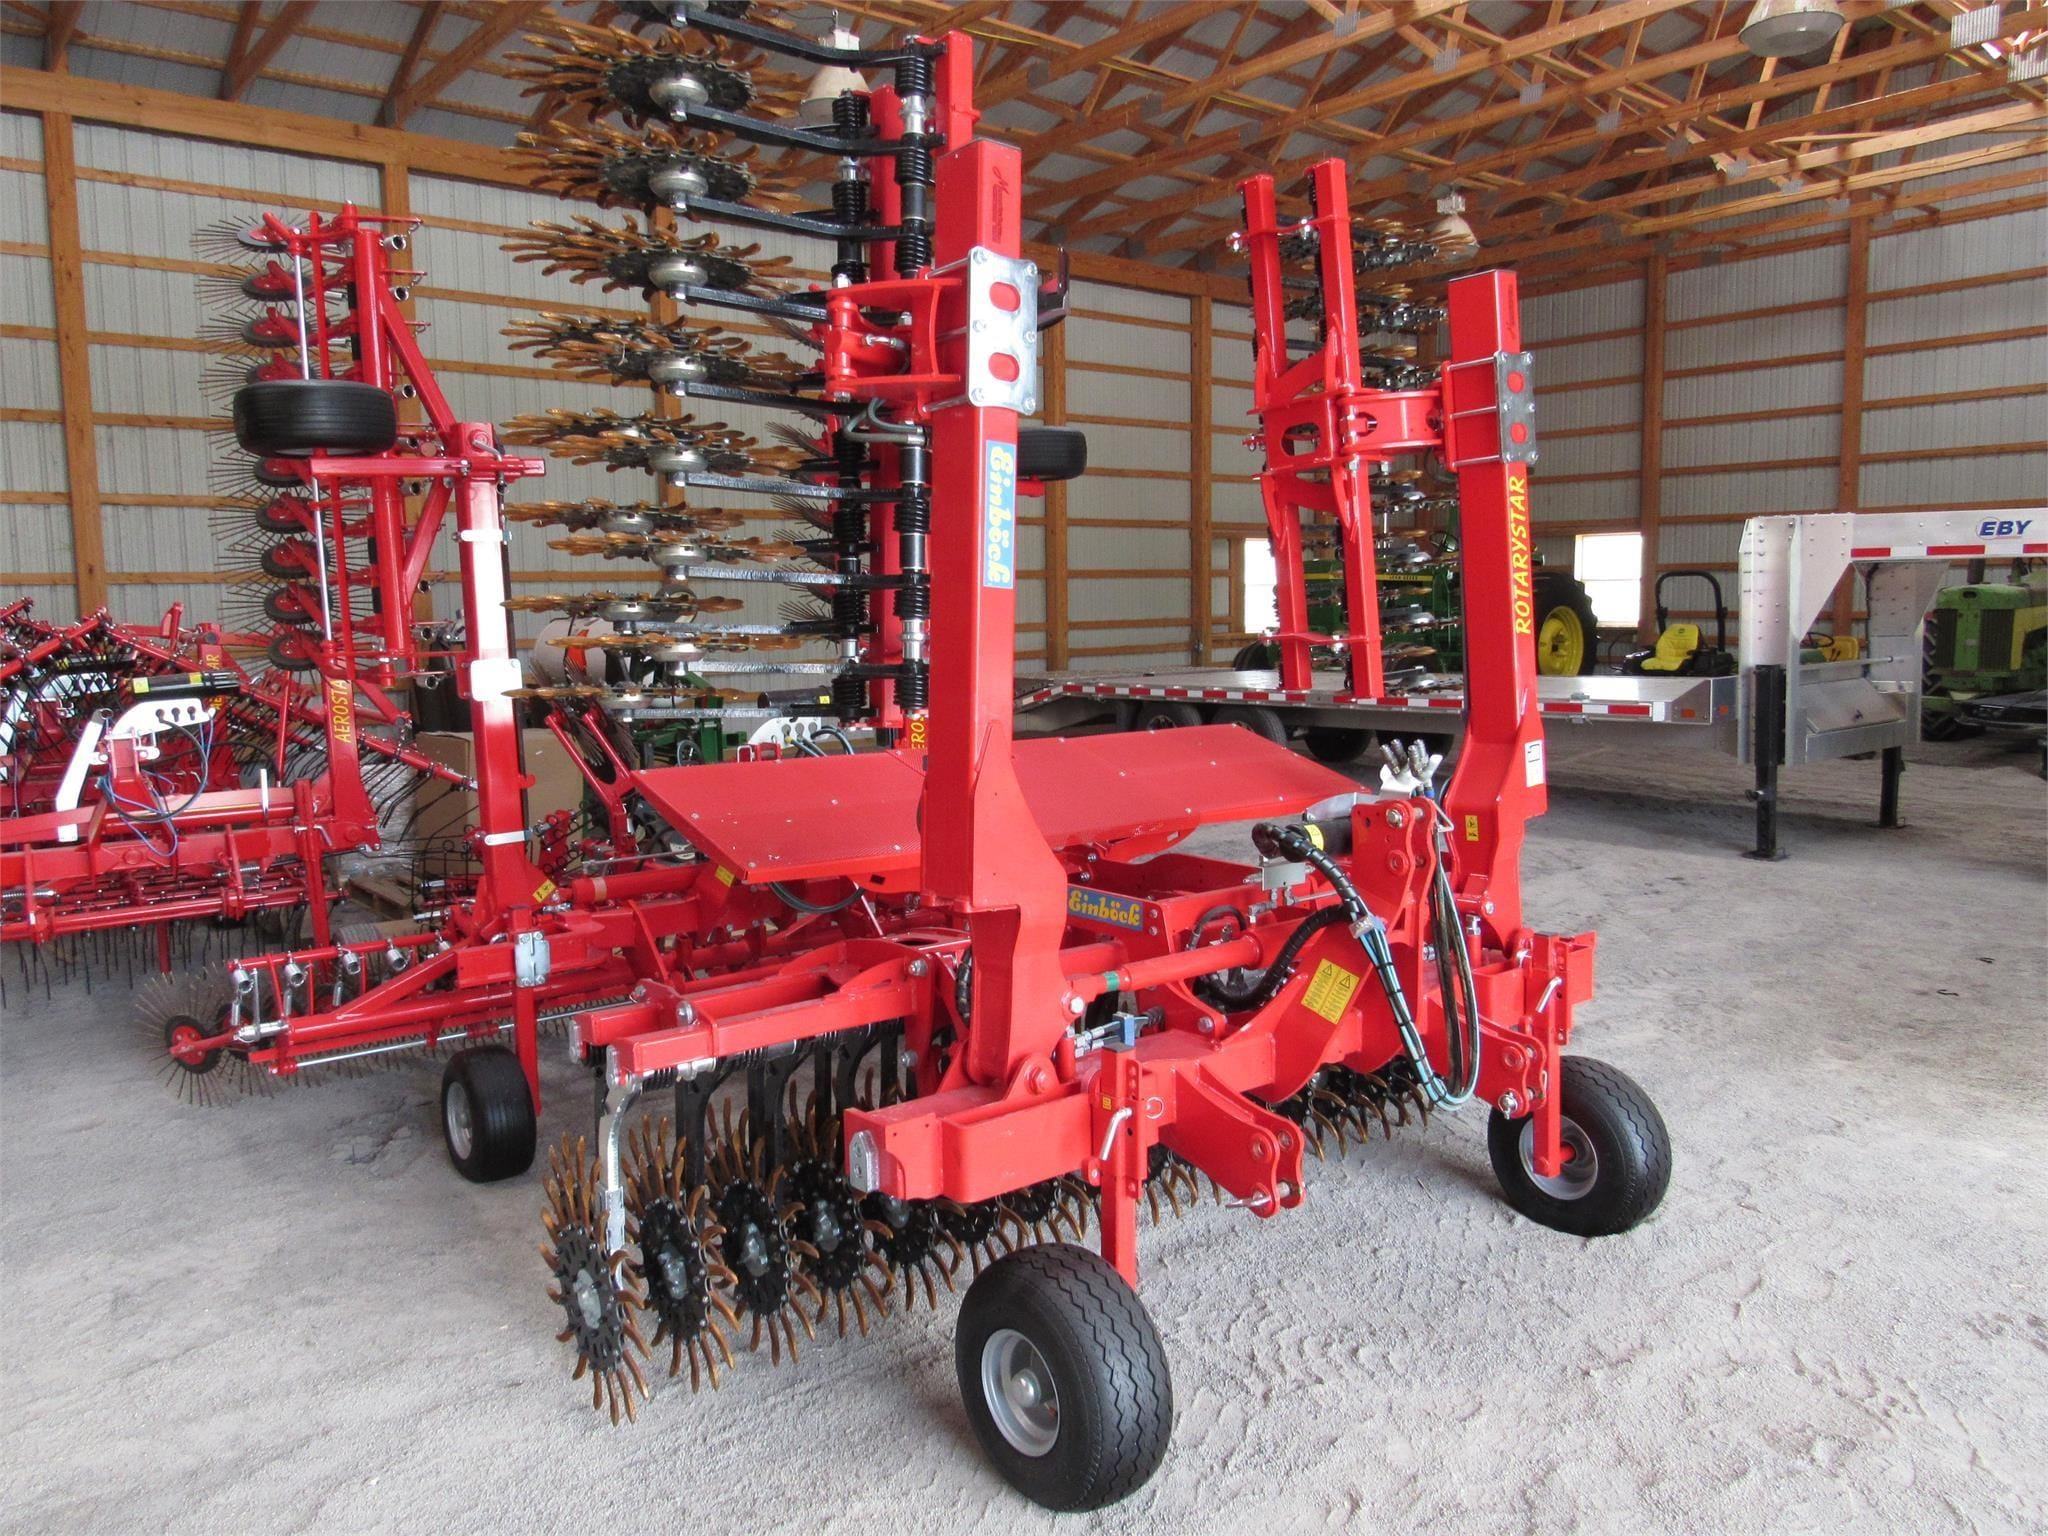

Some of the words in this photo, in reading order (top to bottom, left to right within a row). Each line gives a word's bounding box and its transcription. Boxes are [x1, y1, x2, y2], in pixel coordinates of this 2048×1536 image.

[988, 446, 1014, 583] Einböck
[1979, 519, 2033, 536] EBY
[1508, 476, 1532, 635] ROTARYSTAR
[329, 679, 352, 743] AEROSTA
[1068, 890, 1140, 926] Einböck
